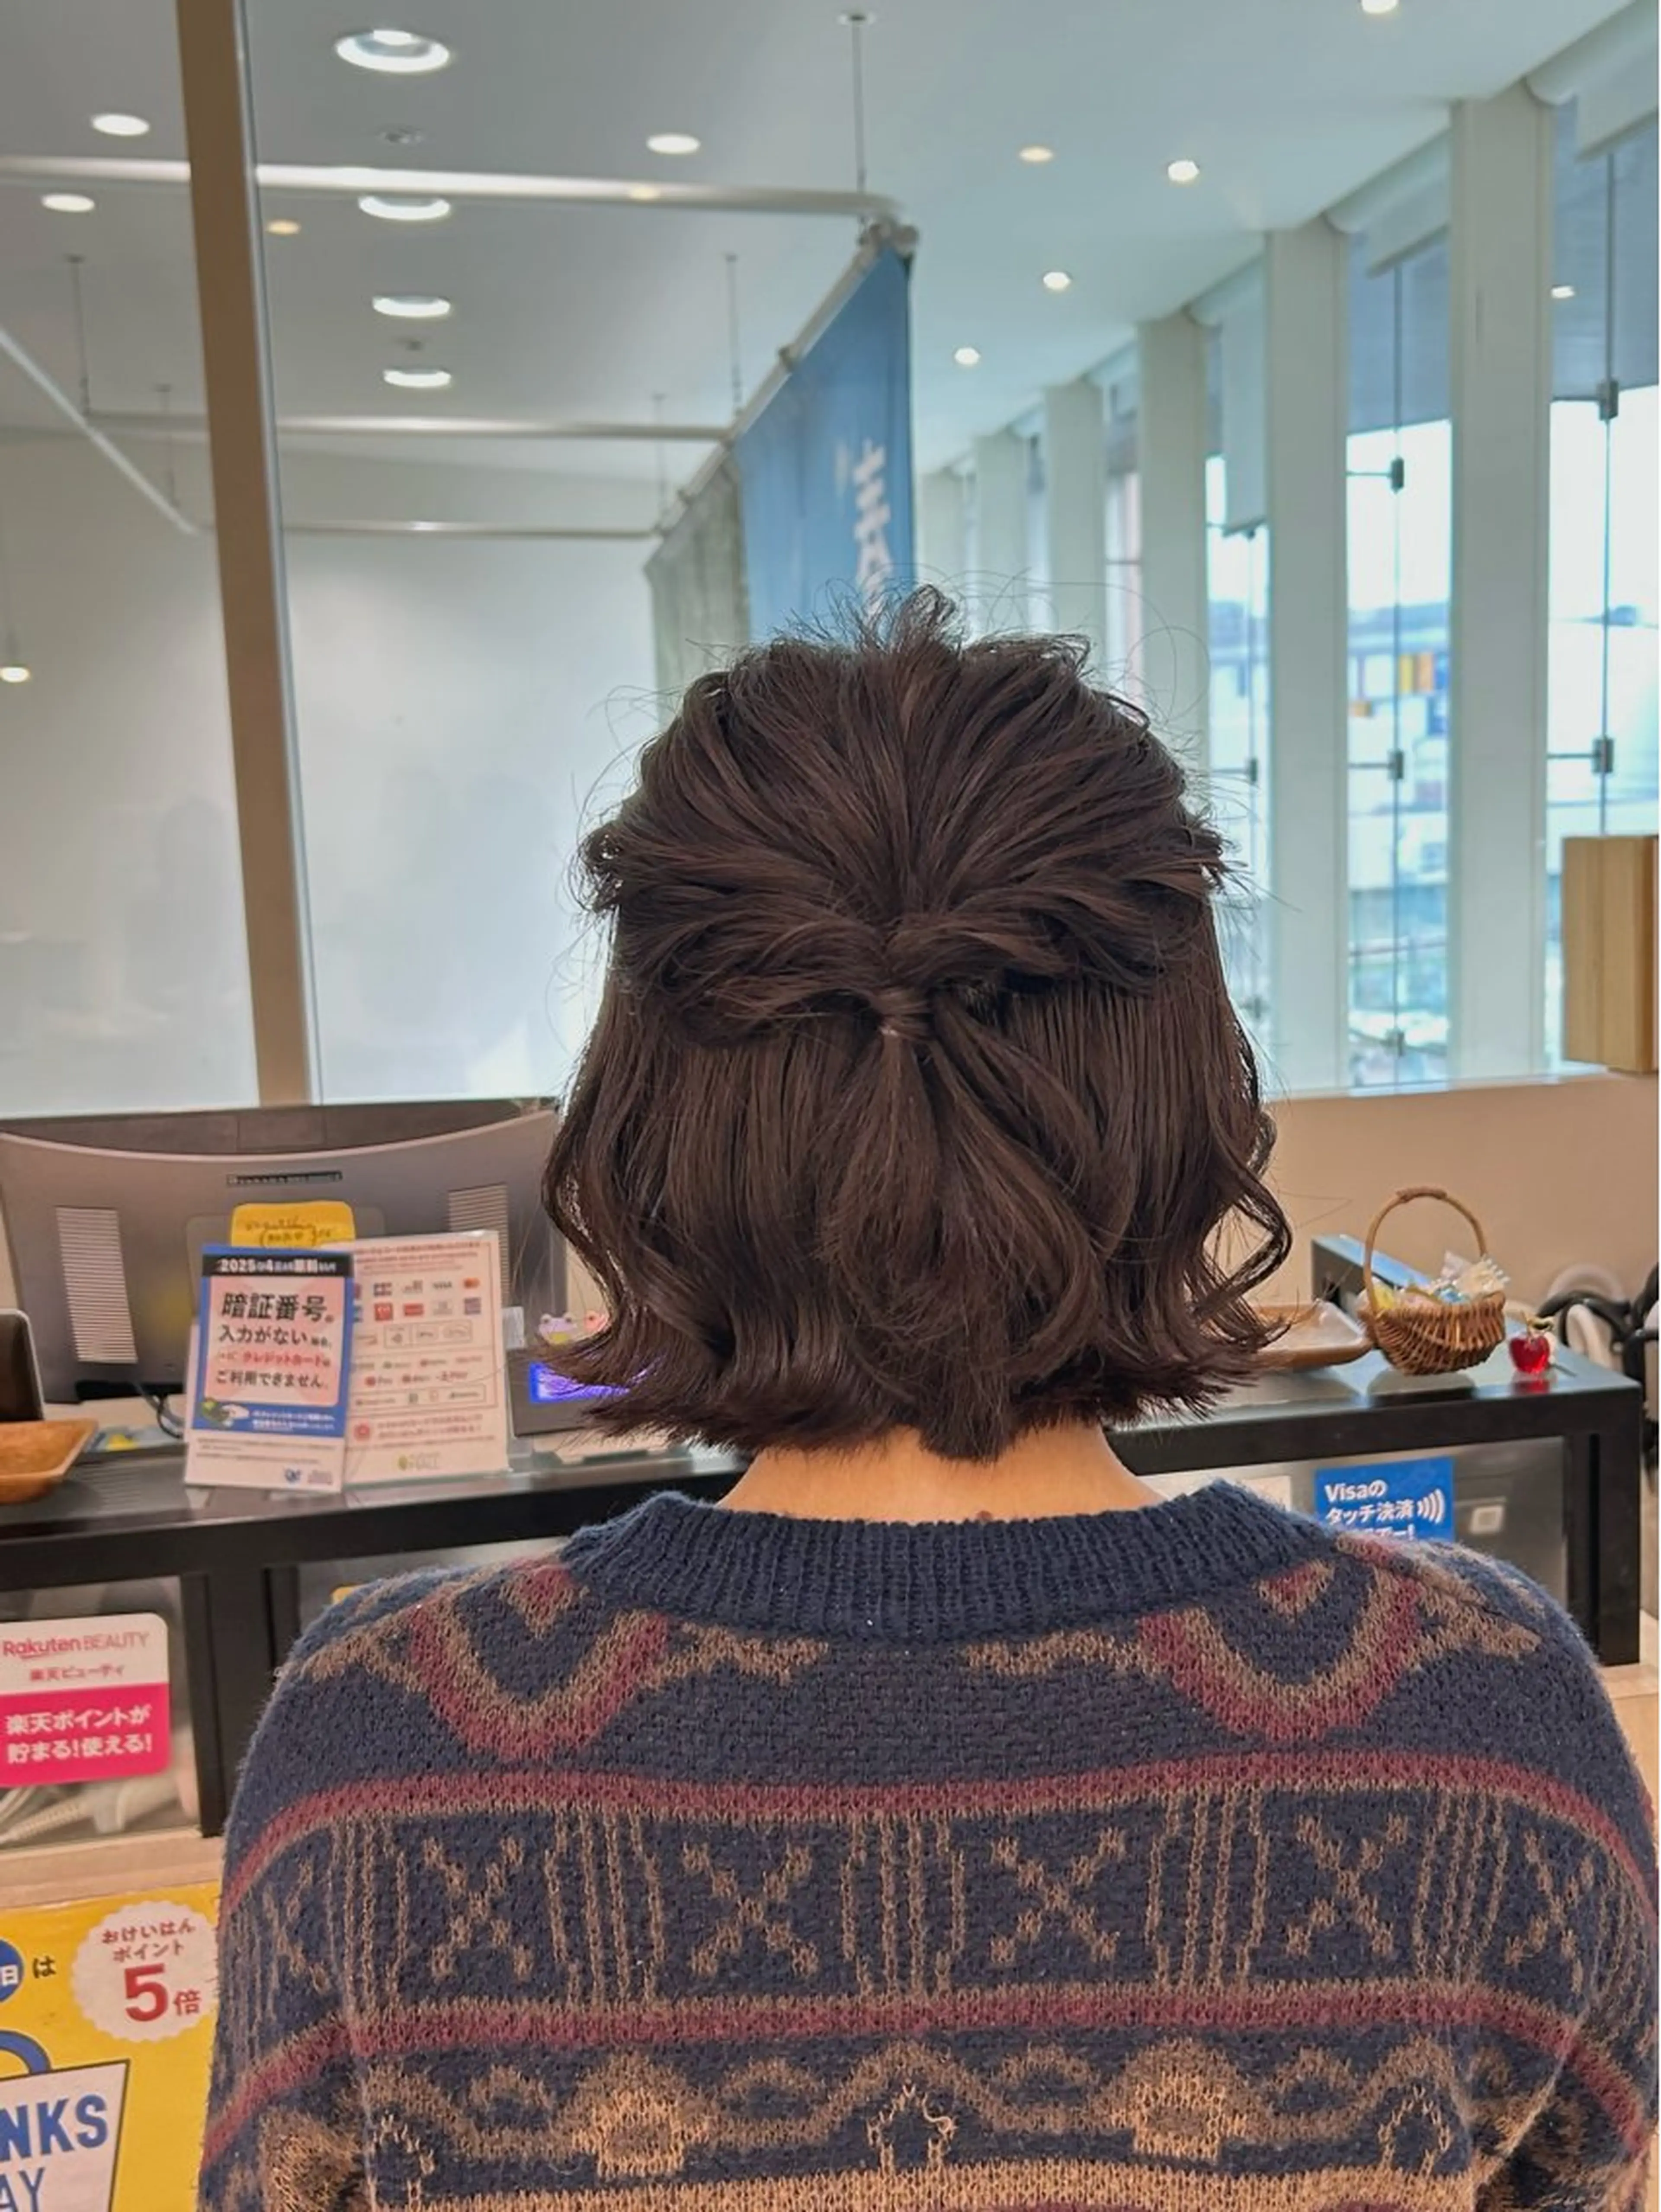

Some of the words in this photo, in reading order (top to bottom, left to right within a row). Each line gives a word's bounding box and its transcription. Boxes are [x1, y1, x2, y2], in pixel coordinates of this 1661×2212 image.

[1324, 1480, 1387, 1502] Visaの
[1325, 1498, 1414, 1525] タッチ決済
[3, 1638, 81, 1658] Rakuten
[83, 1631, 149, 1650] BEAUTY
[6, 1704, 152, 1735] 楽天ポイントが
[8, 1733, 152, 1765] 貯まる!使える!
[103, 1918, 196, 1944] おけいはん
[113, 1940, 184, 1962] ポイント
